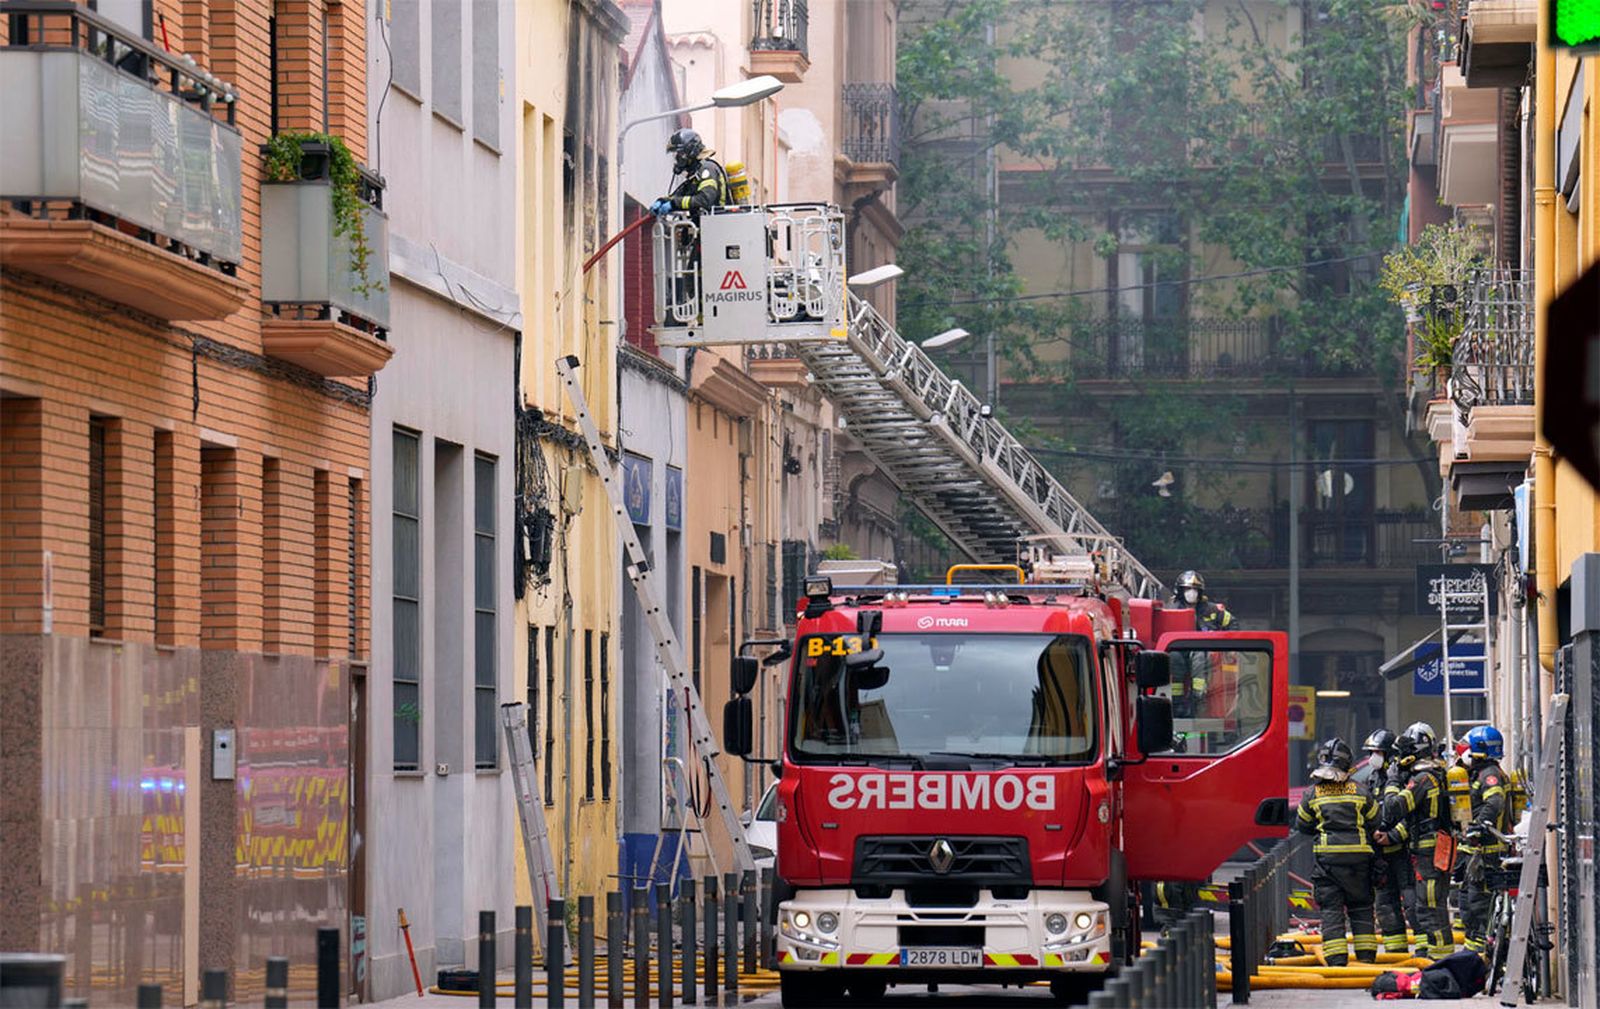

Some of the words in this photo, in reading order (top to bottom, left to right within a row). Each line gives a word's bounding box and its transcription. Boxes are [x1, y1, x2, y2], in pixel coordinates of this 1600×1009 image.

[705, 291, 763, 303] MAGIRUS
[910, 951, 946, 964] 2878
[952, 951, 979, 964] LDW
